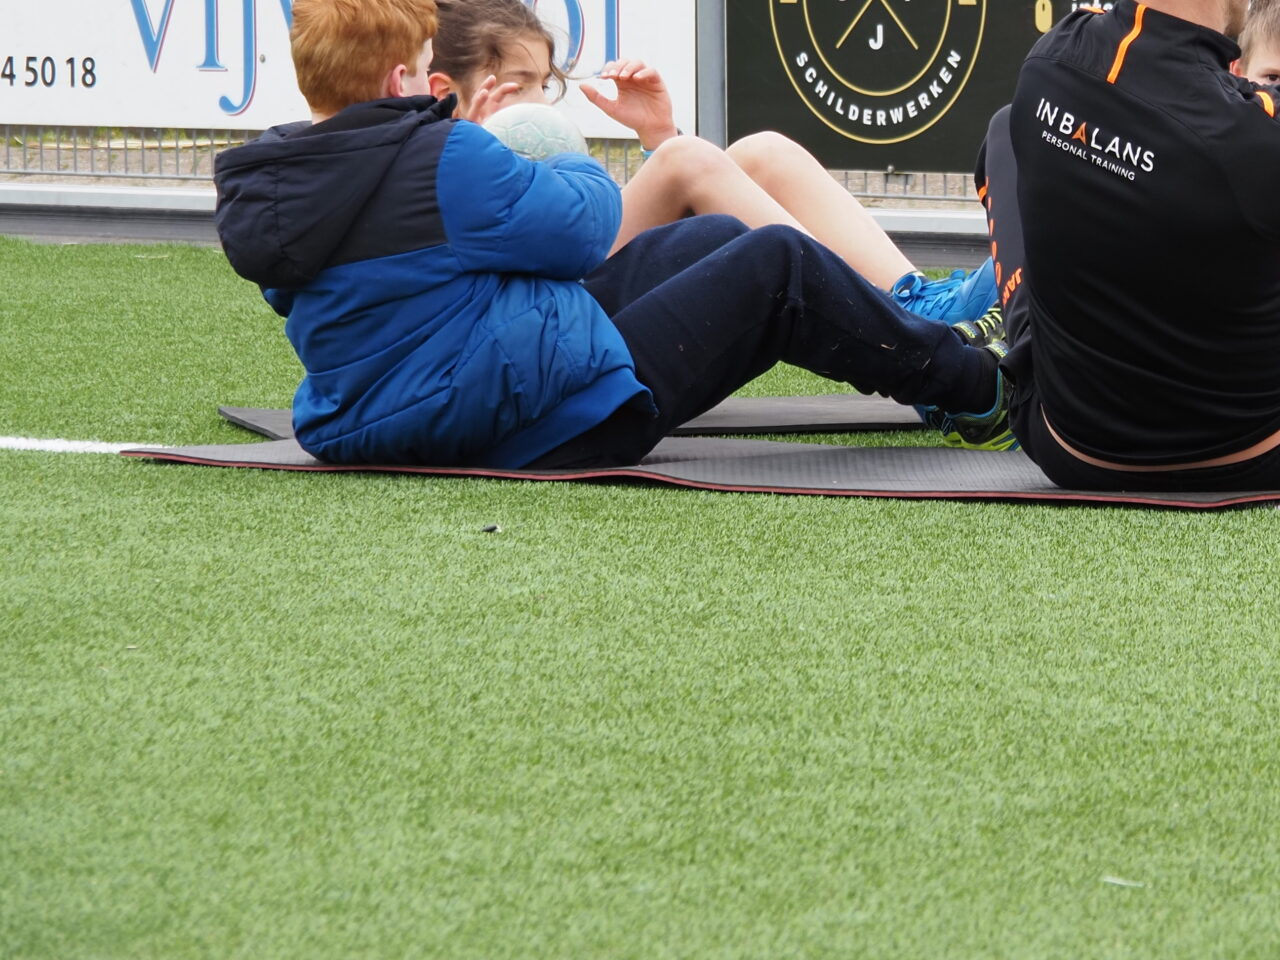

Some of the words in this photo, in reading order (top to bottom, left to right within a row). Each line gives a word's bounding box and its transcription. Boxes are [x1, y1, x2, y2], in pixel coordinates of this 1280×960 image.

[869, 24, 883, 50] J
[1, 56, 16, 86] 4
[25, 56, 56, 87] 50
[66, 57, 96, 88] 18
[796, 50, 961, 126] SCHILDERWERKEN
[1042, 130, 1087, 160] PERSONAL
[1091, 154, 1135, 181] TRAINING
